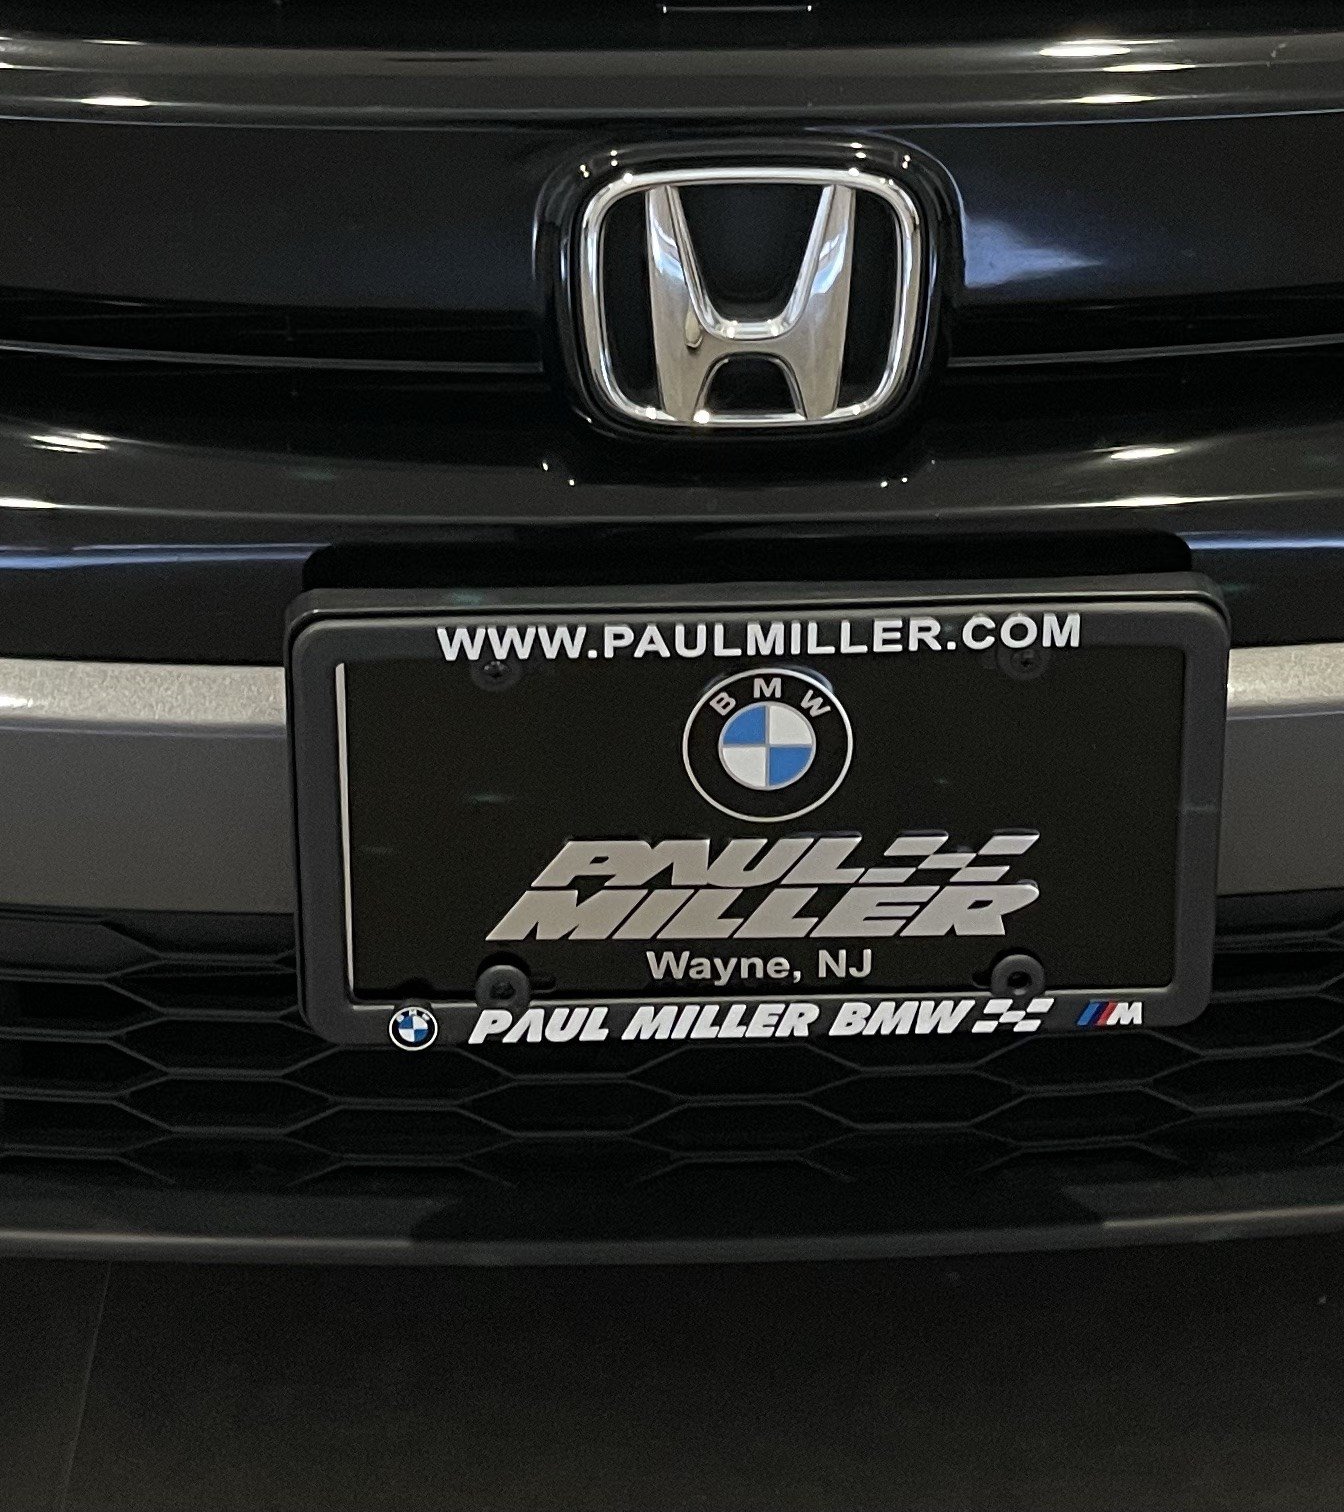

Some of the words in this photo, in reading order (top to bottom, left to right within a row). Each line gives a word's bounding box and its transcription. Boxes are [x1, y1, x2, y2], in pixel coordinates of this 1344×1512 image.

[437, 612, 1081, 661] WWW.PAULMILLER.COM
[709, 677, 831, 718] BMW
[530, 835, 865, 887] PAUL
[485, 883, 1040, 941] MILLER
[646, 950, 802, 987] Wayne,
[817, 947, 874, 980] NJ
[468, 1007, 610, 1044] PAUL
[621, 1001, 820, 1040] MILLER
[828, 999, 976, 1036] BMW
